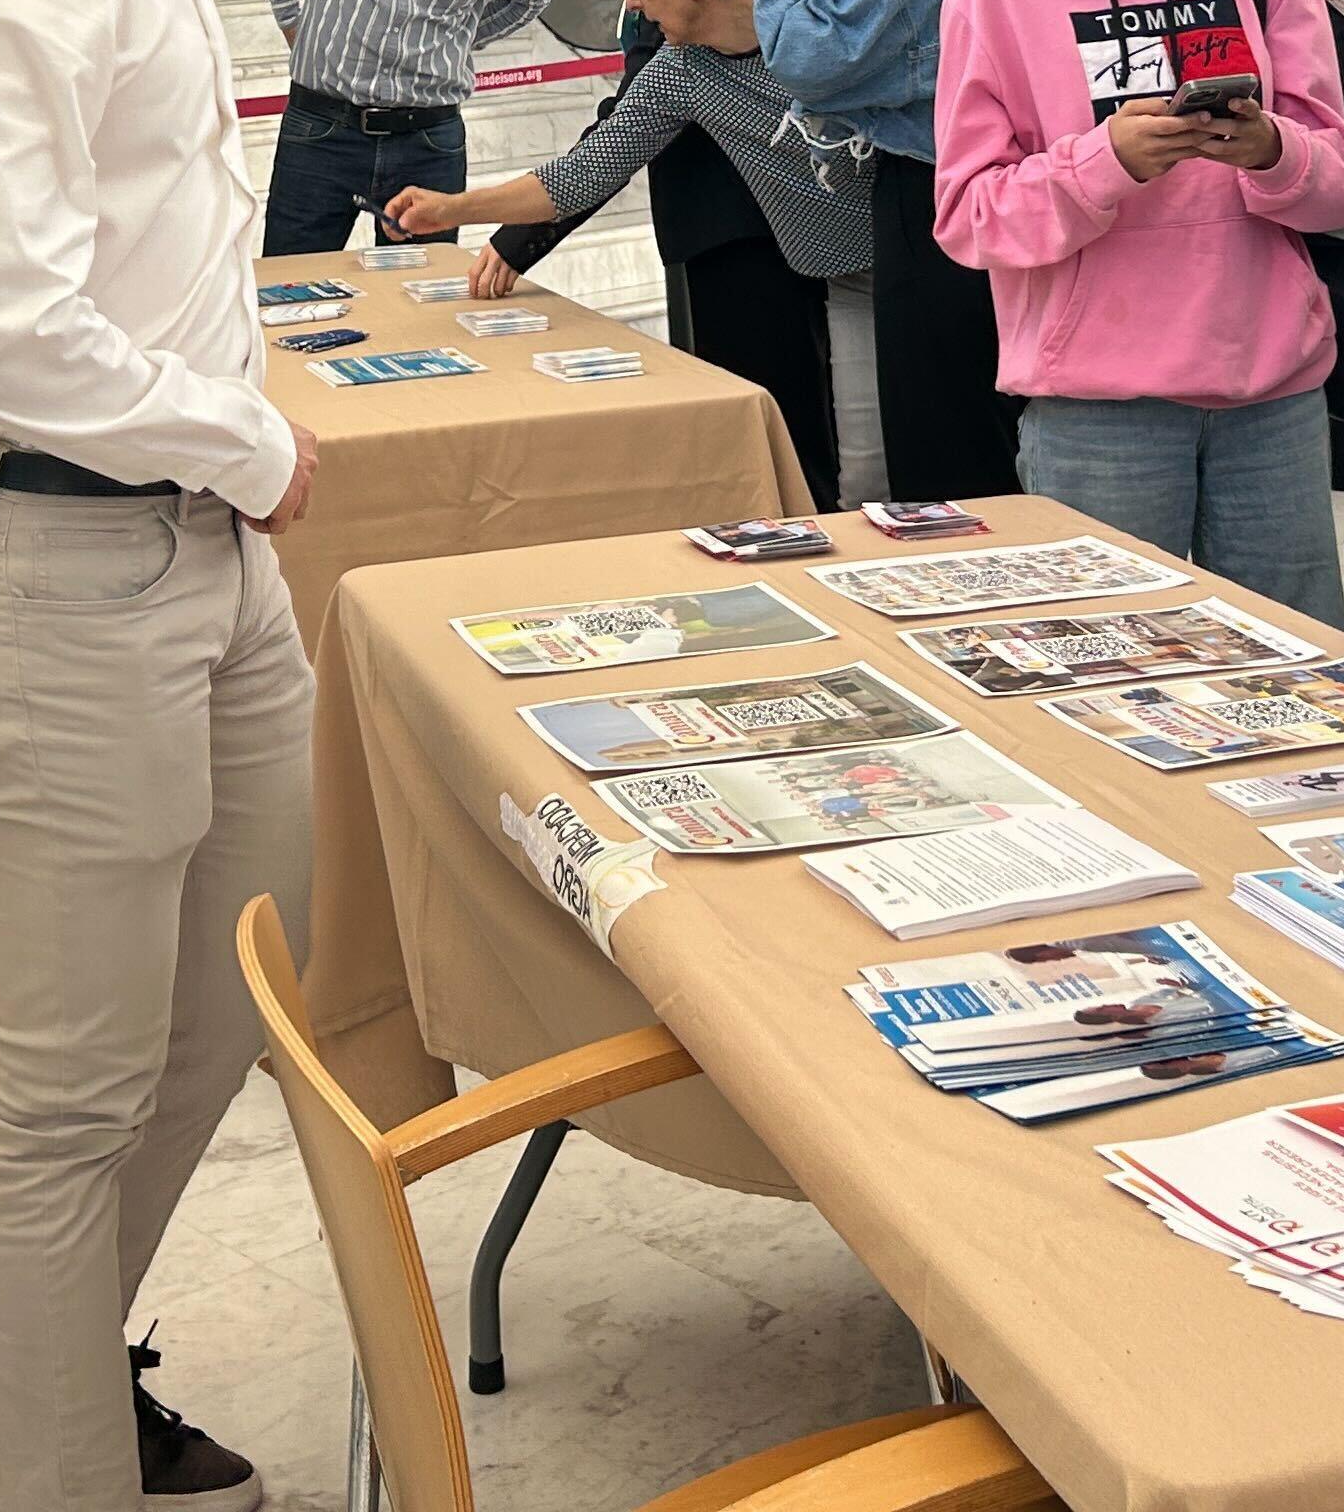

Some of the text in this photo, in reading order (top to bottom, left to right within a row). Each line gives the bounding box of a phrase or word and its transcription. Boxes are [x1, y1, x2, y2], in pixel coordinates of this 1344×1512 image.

[1095, 1, 1216, 34] TOMMY
[537, 797, 605, 867] MERCADO
[553, 854, 593, 926] AGRO
